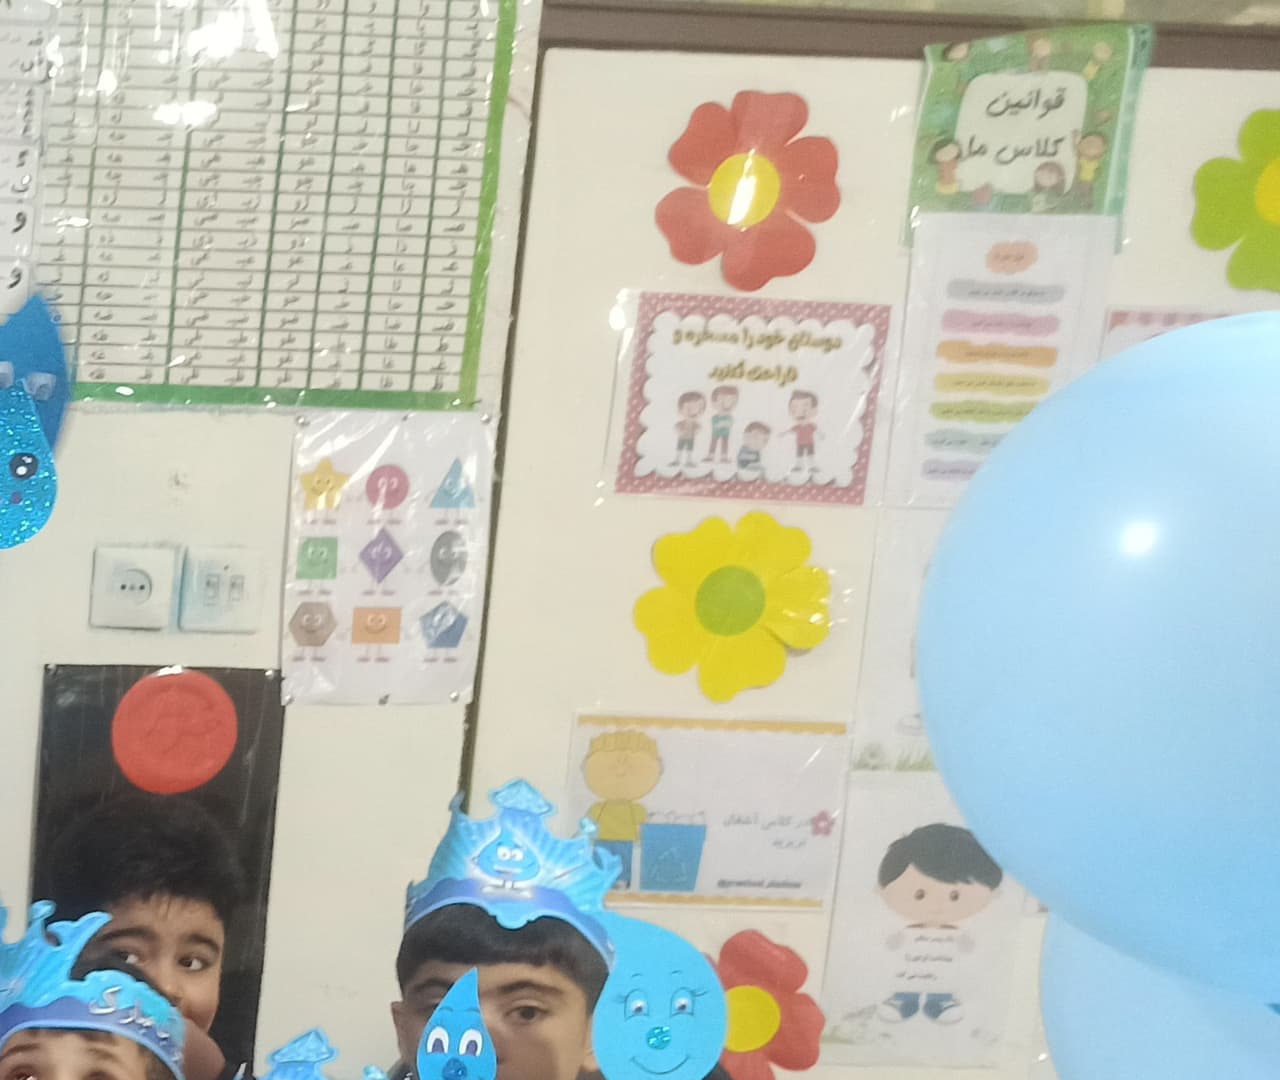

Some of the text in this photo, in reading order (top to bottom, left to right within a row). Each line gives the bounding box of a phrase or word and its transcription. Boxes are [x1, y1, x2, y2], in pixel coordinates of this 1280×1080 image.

[985, 87, 1067, 120] قوانین
[968, 134, 1065, 165] کلاس ما
[742, 327, 755, 350] را
[755, 330, 785, 350] خود
[787, 330, 843, 353] دوستان
